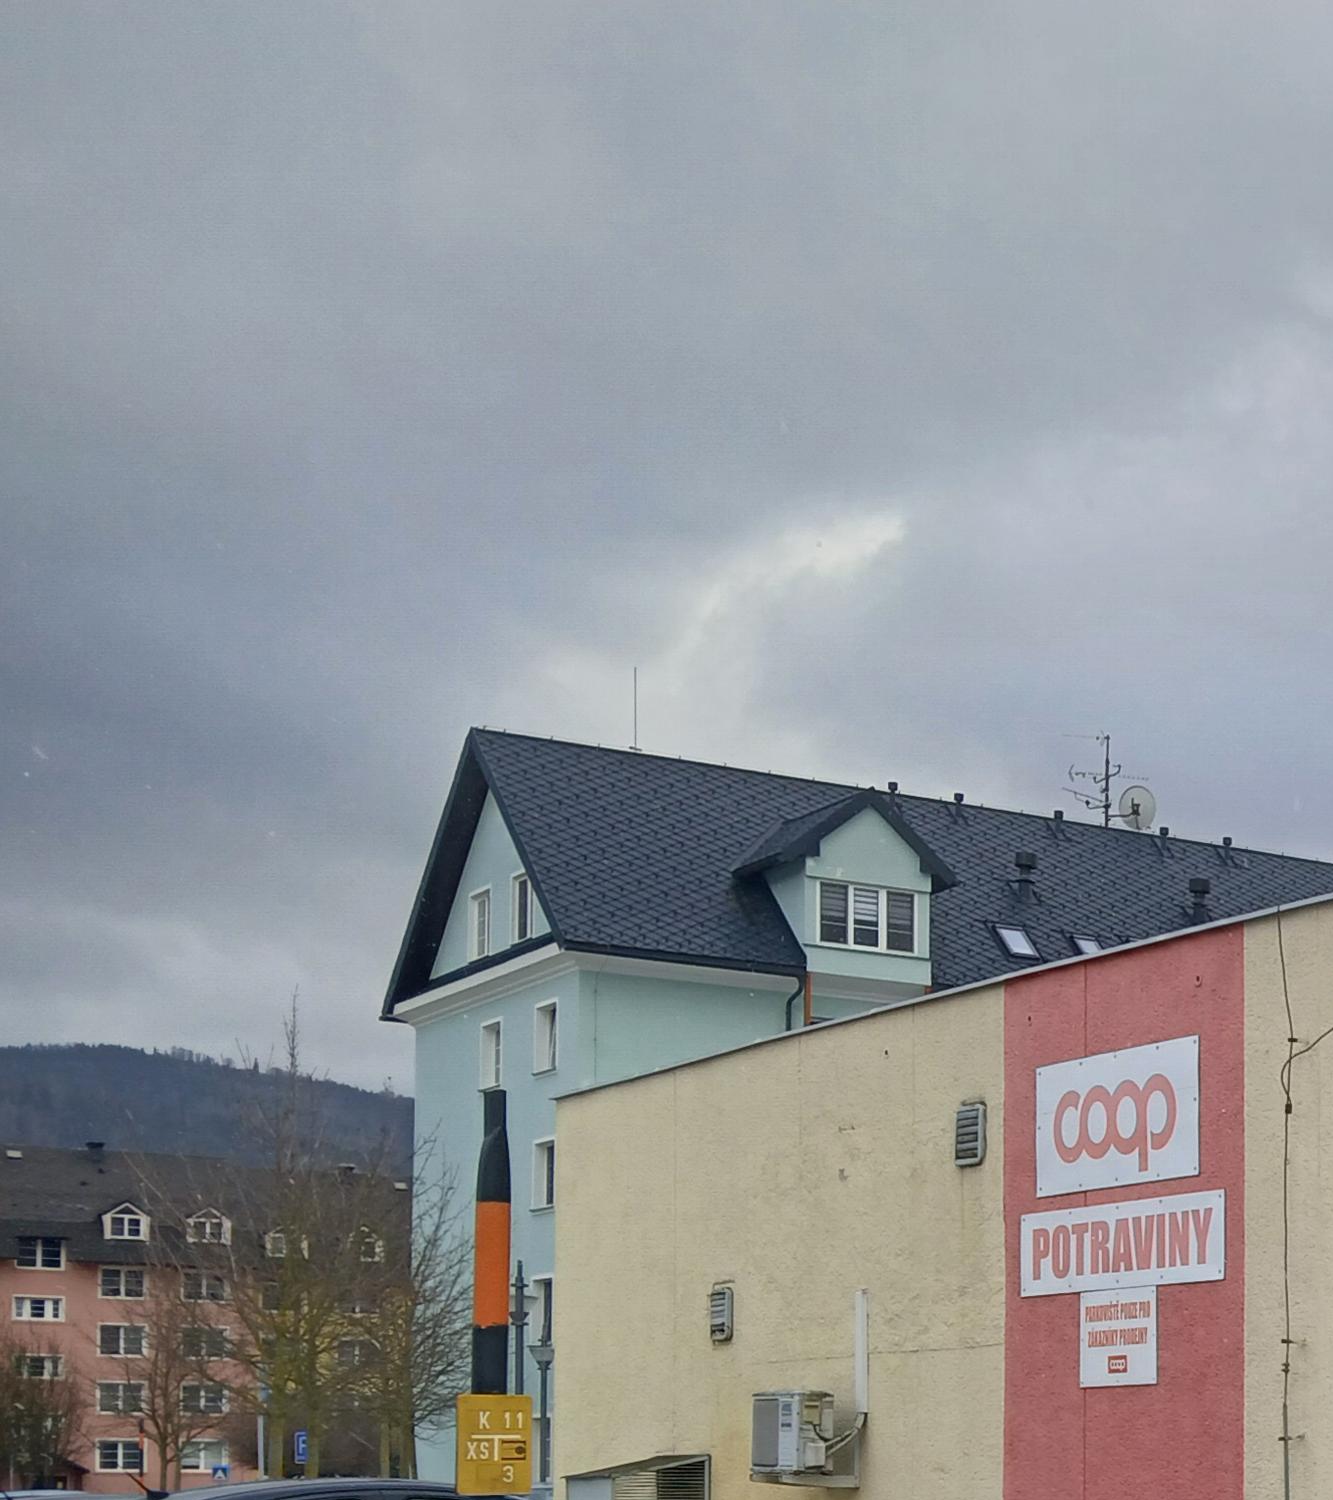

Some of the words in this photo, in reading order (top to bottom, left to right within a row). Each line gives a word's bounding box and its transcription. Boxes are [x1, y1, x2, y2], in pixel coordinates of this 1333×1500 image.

[1053, 1073, 1177, 1172] coop
[1032, 1207, 1213, 1281] POTRAVINY
[479, 1410, 491, 1429] K
[504, 1411, 523, 1429] 11
[466, 1442, 489, 1460] XS
[502, 1465, 514, 1483] 3
